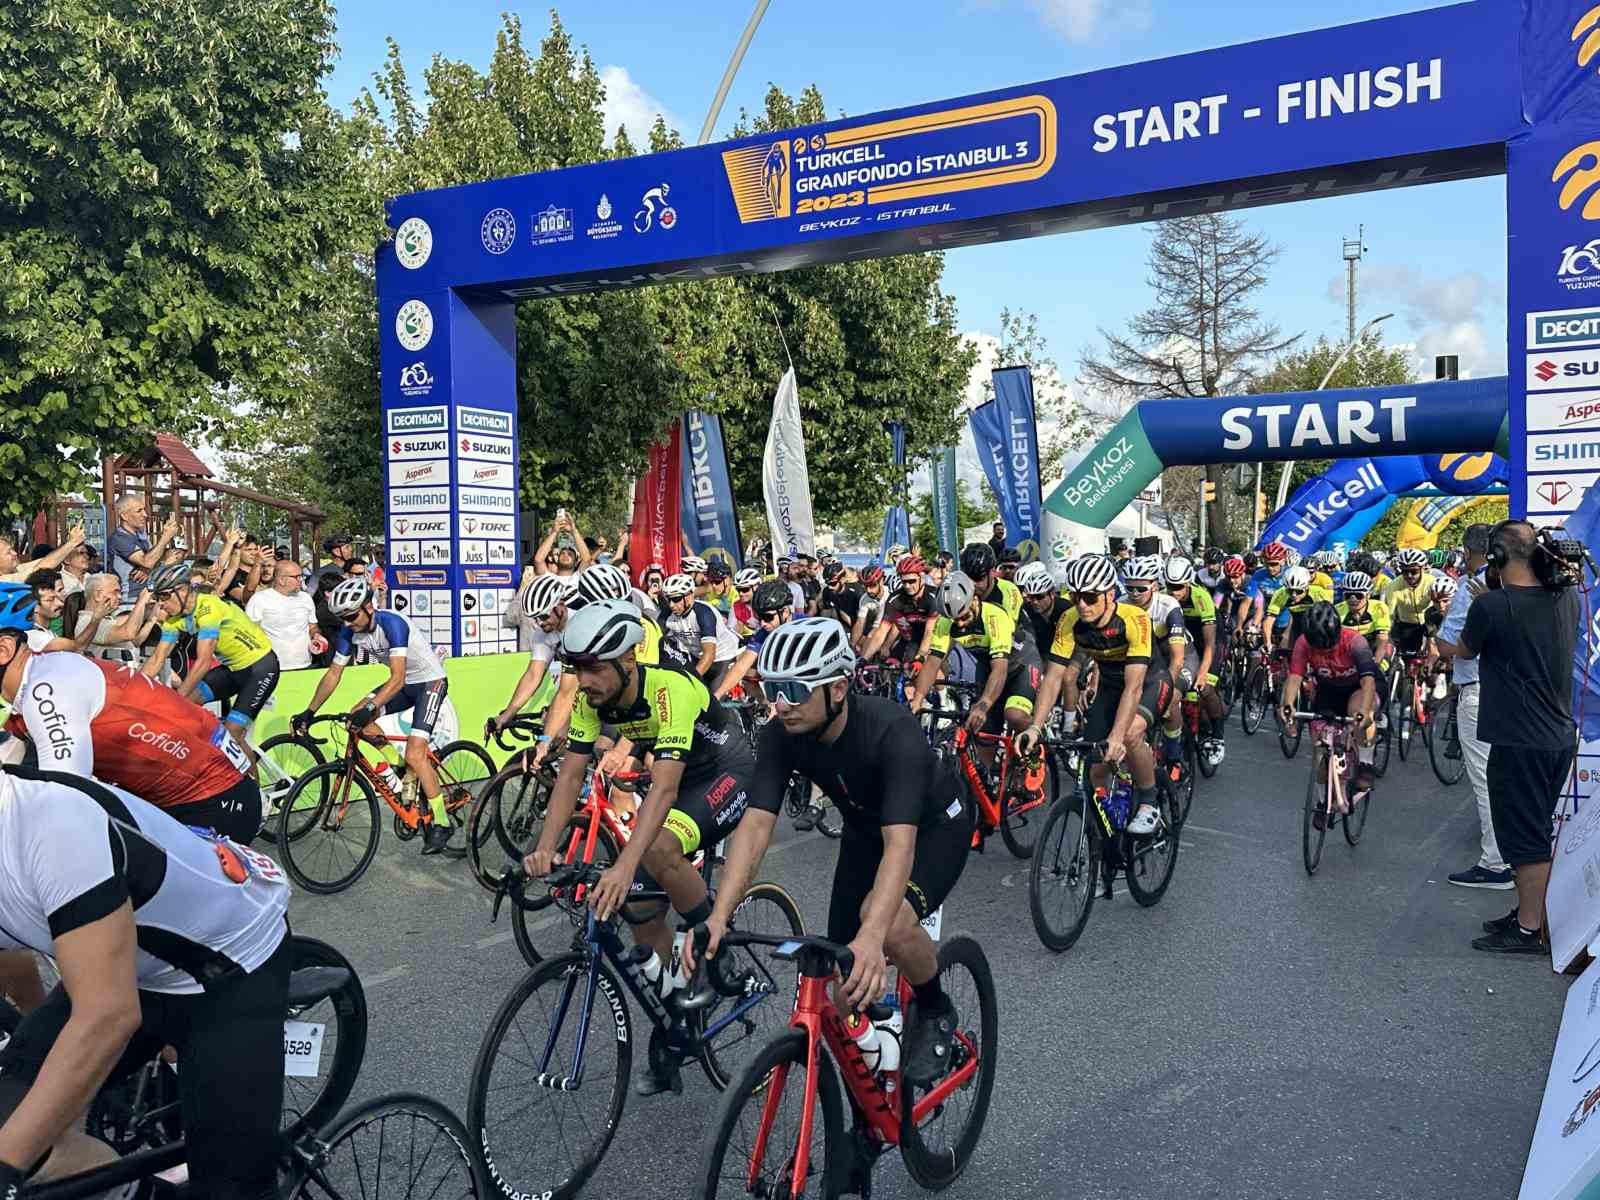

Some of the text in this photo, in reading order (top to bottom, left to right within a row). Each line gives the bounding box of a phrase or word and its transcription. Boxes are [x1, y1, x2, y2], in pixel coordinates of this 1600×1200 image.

[1092, 58, 1442, 153] START - FINISH
[796, 144, 885, 172] TURKCELL
[796, 140, 1029, 193] GRANFONDO İSTANBUL 3
[796, 190, 865, 214] 2023
[799, 215, 861, 233] BEYKOZ
[1542, 319, 1600, 337] DECAT
[393, 413, 442, 427] DECATHLON
[1564, 402, 1600, 420] Aspe
[463, 413, 507, 429] DECATHLON
[1221, 396, 1417, 450] START
[404, 440, 446, 452] SUZUKI
[472, 442, 511, 456] SUZUKI
[1535, 442, 1600, 461] SHIM
[1064, 437, 1134, 506] Beykoz
[1085, 457, 1136, 508] Belediyesi
[393, 494, 447, 506] SHIMANO
[462, 494, 512, 507] SHIMANO
[412, 521, 447, 531] TORC
[480, 522, 511, 532] TORC
[396, 551, 416, 563] Juss
[464, 551, 484, 563] Juss
[32, 682, 75, 761] Cofidis
[128, 722, 190, 760] Cofidis
[597, 973, 628, 1042] BONTR
[284, 1040, 312, 1056] 1529
